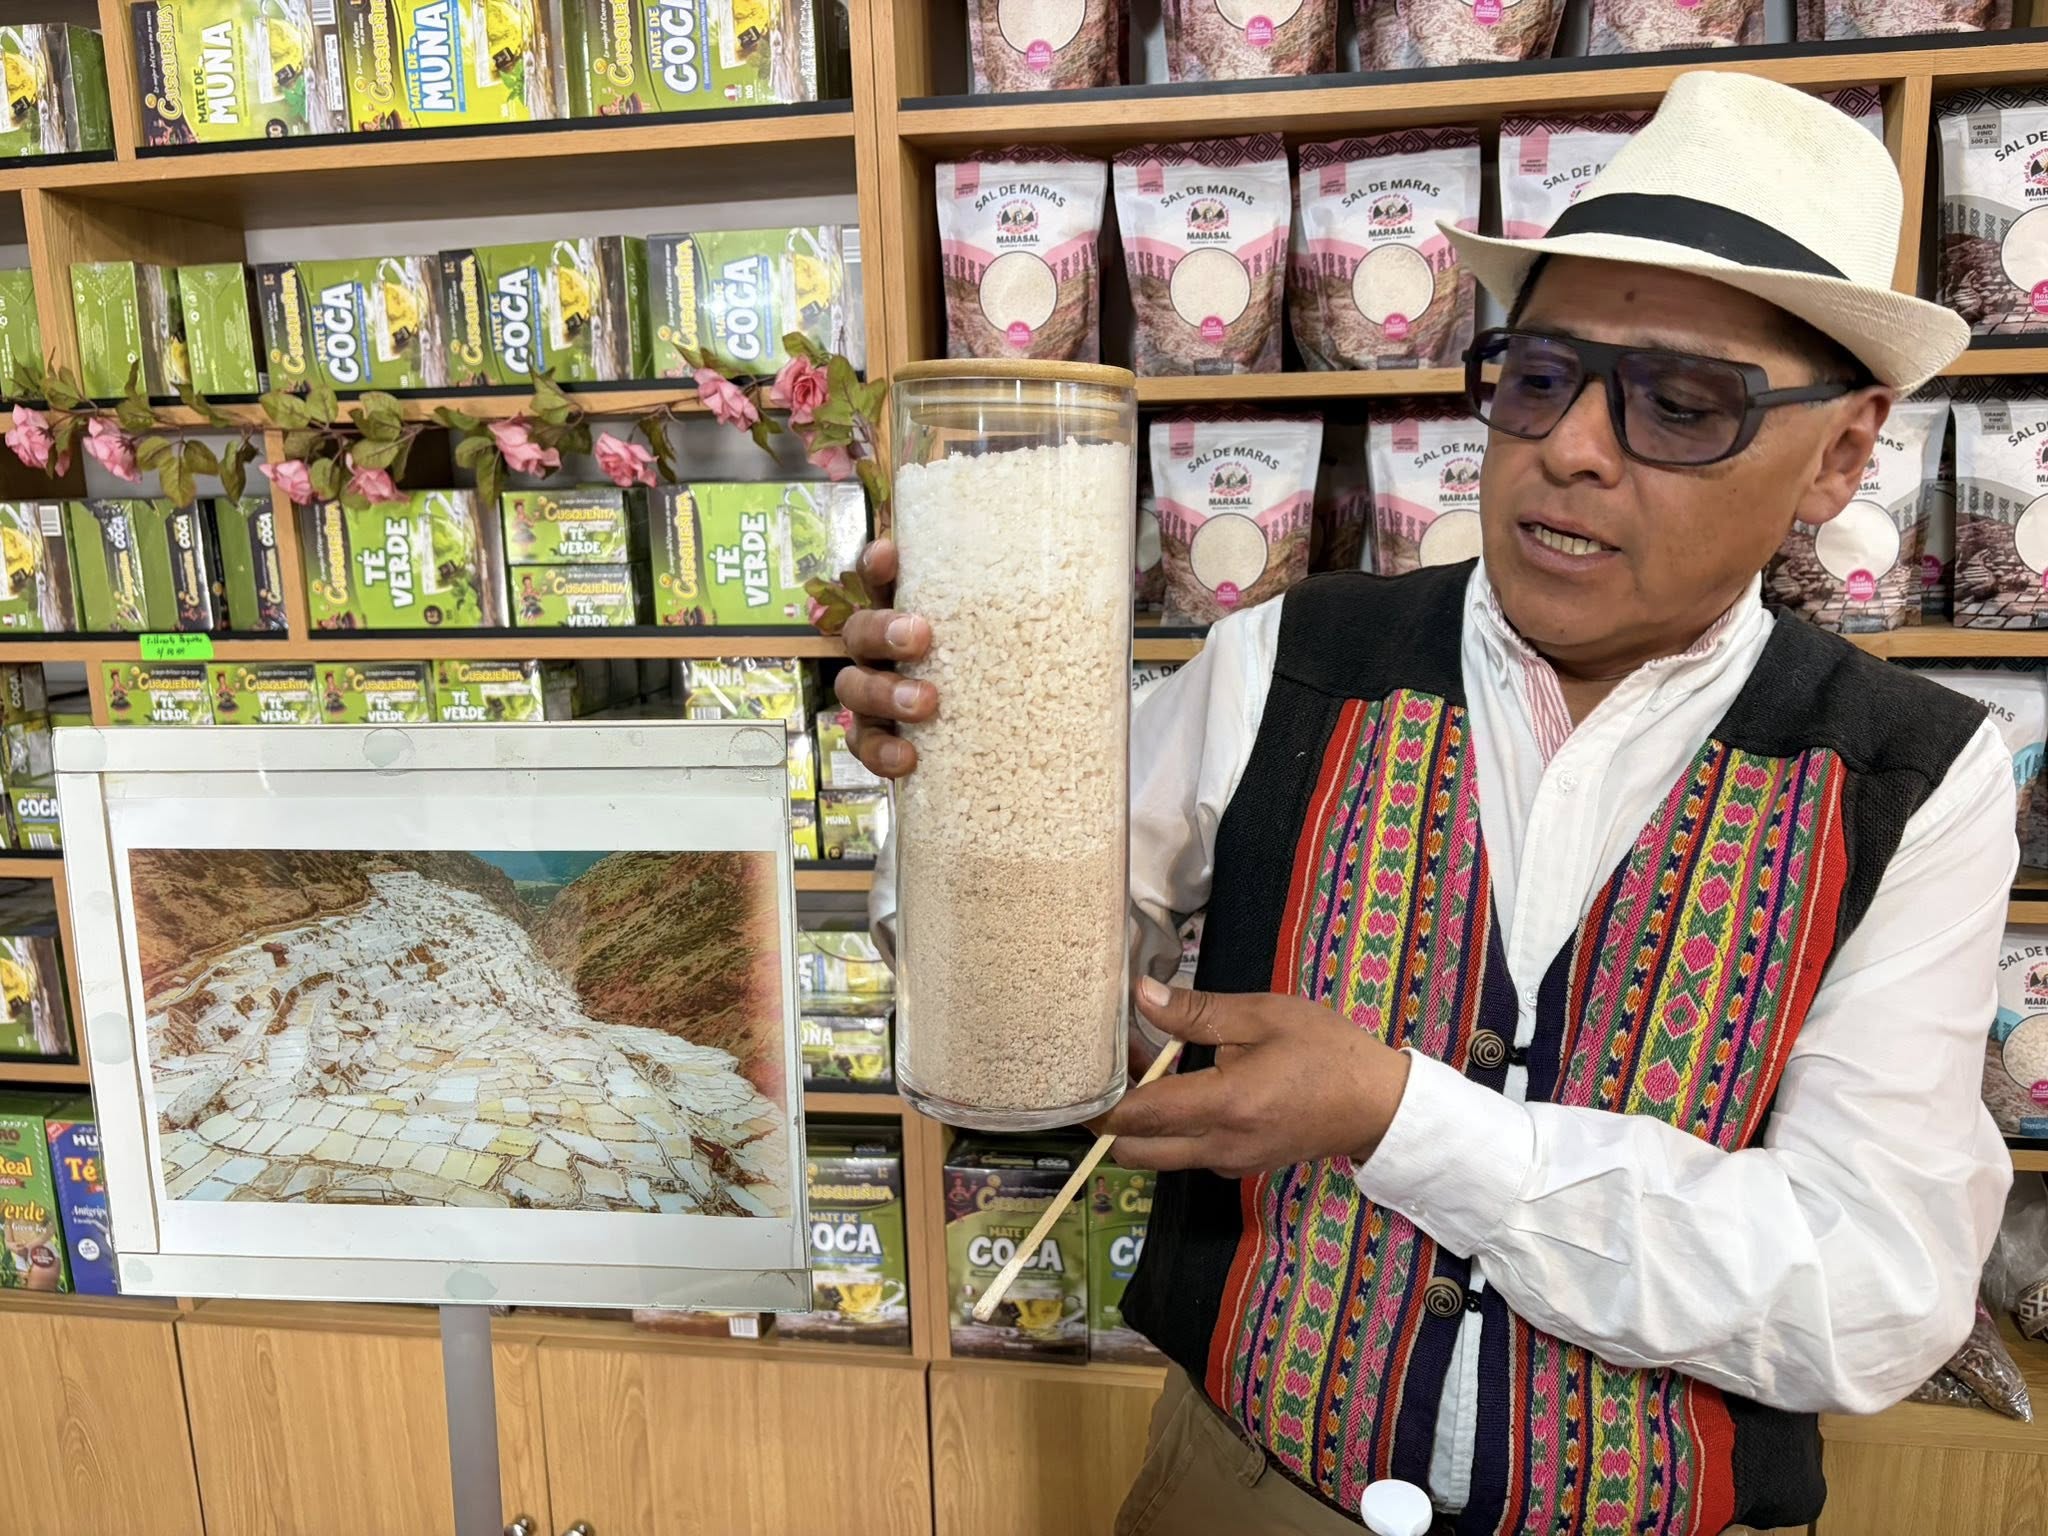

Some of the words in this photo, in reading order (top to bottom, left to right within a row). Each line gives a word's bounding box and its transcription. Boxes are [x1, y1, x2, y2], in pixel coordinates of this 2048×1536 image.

[650, 8, 660, 30] DE
[156, 5, 182, 120] CUSQUEÑITA
[407, 52, 418, 73] DE
[411, 1, 454, 111] MUÑA
[651, 34, 663, 69] MATE
[194, 69, 203, 88] DE
[198, 20, 239, 125] MUÑA
[410, 78, 423, 110] MATE
[196, 92, 208, 123] MATE
[1994, 140, 2025, 162] SAL
[2026, 131, 2048, 146] DE
[1543, 173, 1570, 190] SAL
[1572, 164, 1592, 179] DE
[974, 191, 998, 212] SAL
[1000, 184, 1017, 197] DE
[1020, 184, 1067, 208] MARAS
[1160, 192, 1185, 209] SAL
[1186, 185, 1204, 196] DE
[1207, 184, 1255, 207] MARAS
[1342, 190, 1368, 209] SAL
[1369, 182, 1387, 194] DE
[1390, 178, 1441, 198] MARAS
[996, 234, 1040, 244] MARASAL
[1186, 231, 1232, 240] MARASAL
[1368, 226, 1416, 238] MARASAL
[490, 294, 501, 312] DE
[672, 239, 699, 351] CUSQUEÑITA
[312, 306, 323, 325] DE
[498, 268, 534, 374] COCA
[724, 256, 761, 361] COCA
[314, 326, 329, 365] MATE
[321, 282, 360, 384] COCA
[492, 314, 504, 352] MATE
[2008, 427, 2035, 447] SAL
[1187, 454, 1212, 473] SAL
[1213, 448, 1231, 459] DE
[1234, 447, 1280, 471] MARAS
[1414, 452, 1441, 469] SAL
[1441, 443, 1461, 455] DE
[544, 503, 617, 522] CUSQUEÑITA
[1208, 496, 1253, 506] MARASAL
[112, 516, 126, 550] COCA
[176, 514, 191, 550] COCA
[258, 512, 274, 547] COCA
[568, 523, 586, 541] TÉ
[559, 541, 602, 555] VERDE
[672, 490, 699, 600] CUSQUEÑITA
[357, 549, 387, 587] TÉ
[386, 518, 415, 609] VERDE
[709, 546, 740, 585] TÉ
[740, 514, 770, 608] VERDE
[576, 597, 595, 615] TÉ
[568, 615, 610, 627] VERDE
[458, 664, 525, 683] CUSQUEÑITA
[452, 688, 470, 706] TÉ
[152, 709, 190, 722] VERDE
[260, 710, 299, 724] VERDE
[367, 710, 406, 723] VERDE
[442, 706, 487, 721] VERDE
[1998, 952, 2025, 971] SAL
[2024, 946, 2043, 958] DE
[64, 1157, 98, 1183] Té
[809, 1184, 895, 1201] USQUEÑITA
[843, 1213, 859, 1224] DE
[810, 1224, 882, 1255] OCA
[988, 1226, 1022, 1238] MATE
